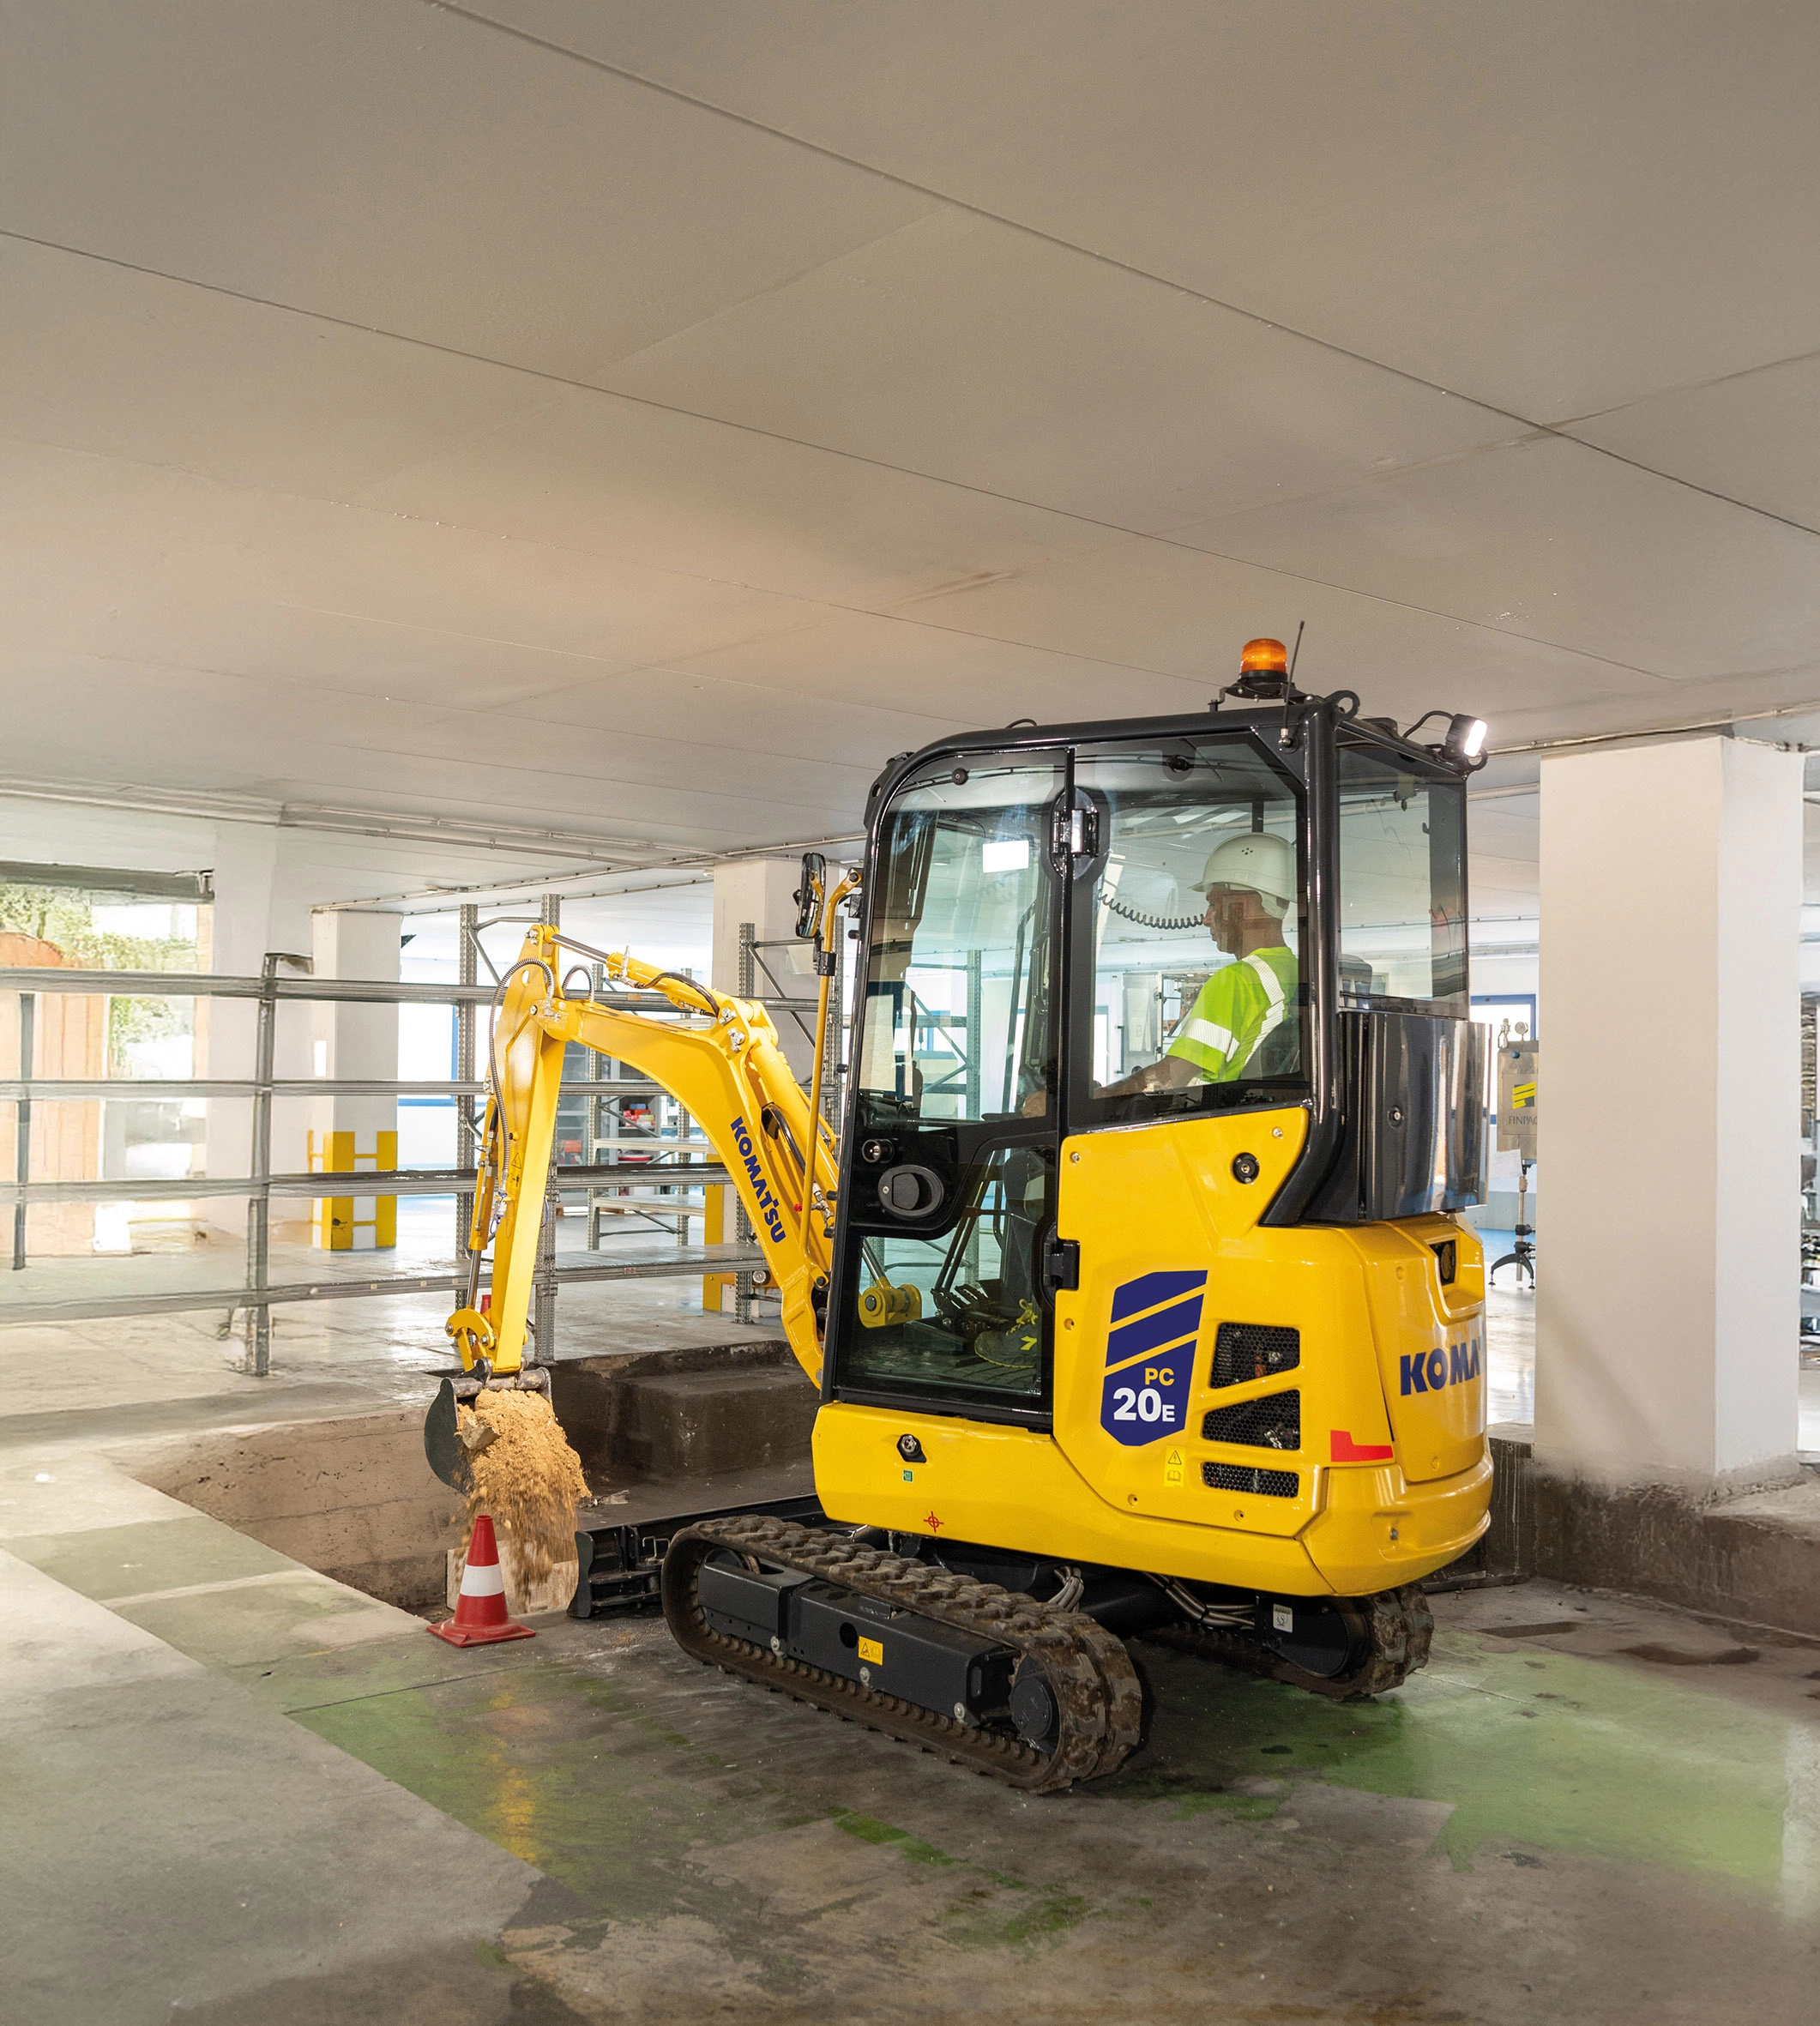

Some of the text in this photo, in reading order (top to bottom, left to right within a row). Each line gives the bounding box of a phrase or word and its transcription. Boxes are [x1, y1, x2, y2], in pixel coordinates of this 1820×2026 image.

[730, 1115, 786, 1244] KOMATSU
[1144, 1367, 1175, 1386] PC
[1112, 1387, 1176, 1423] 20E
